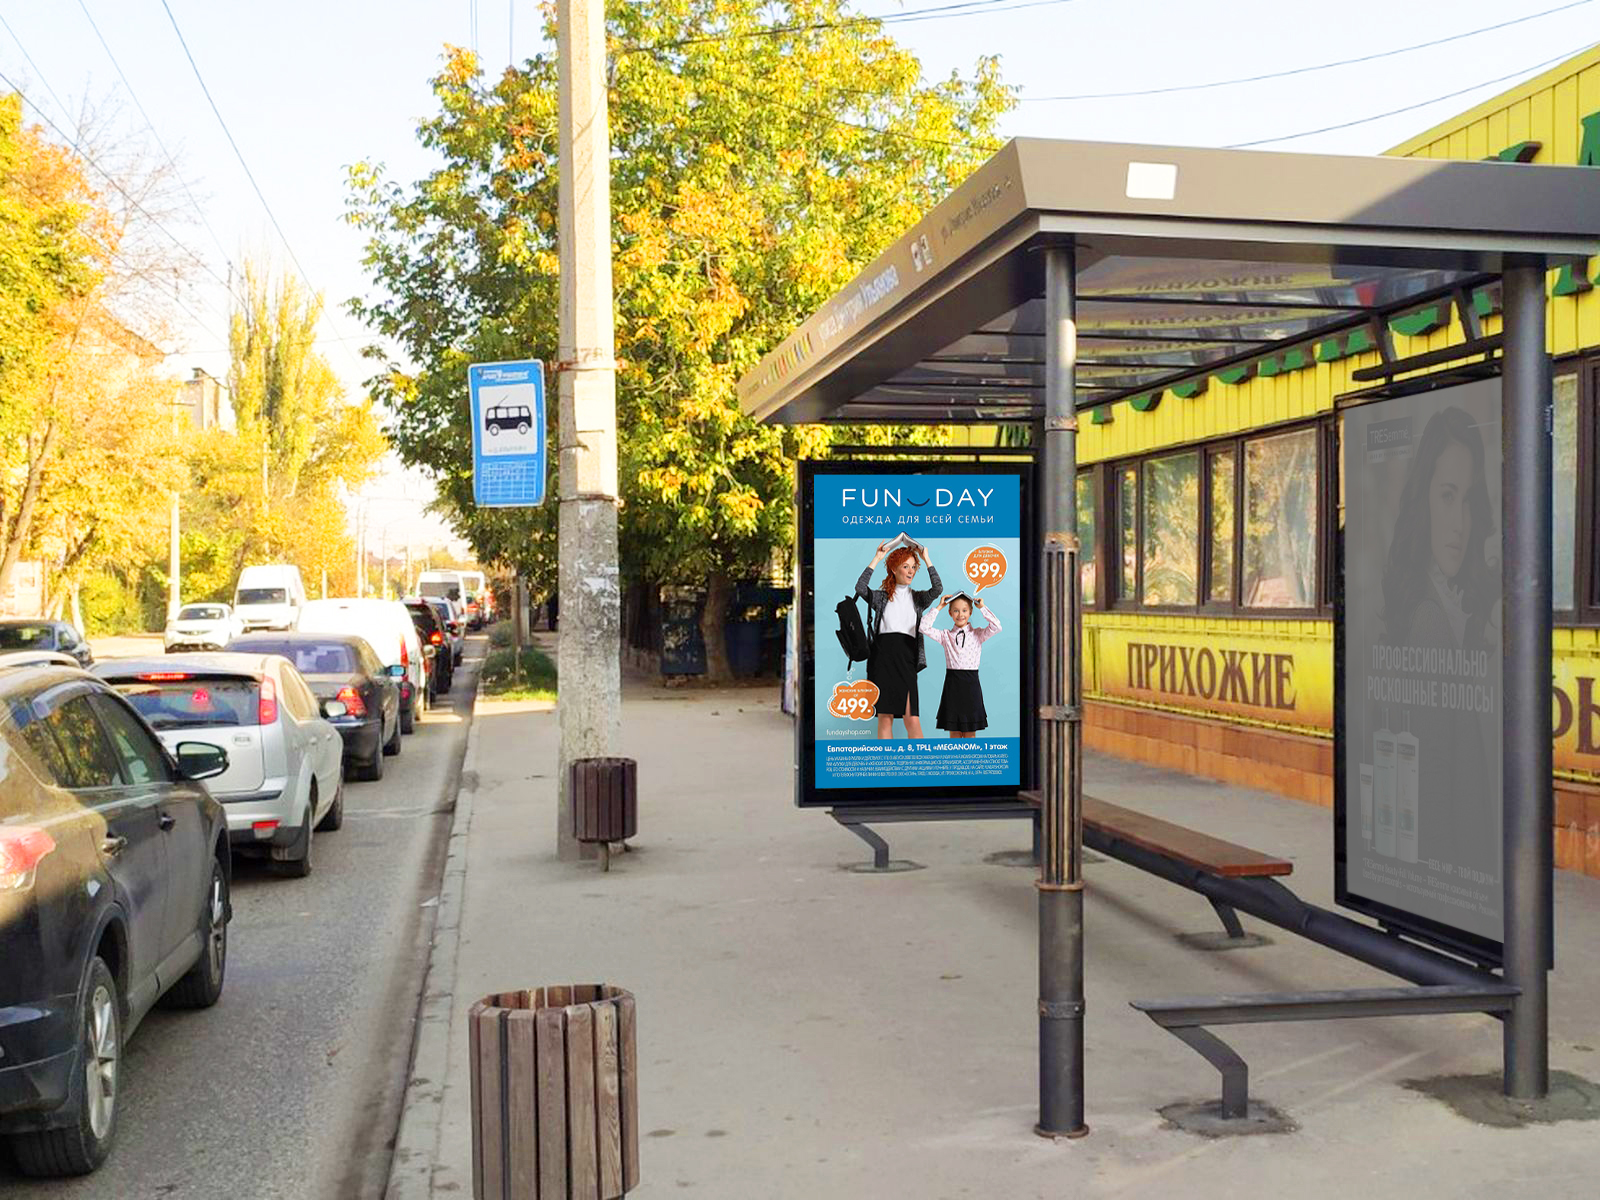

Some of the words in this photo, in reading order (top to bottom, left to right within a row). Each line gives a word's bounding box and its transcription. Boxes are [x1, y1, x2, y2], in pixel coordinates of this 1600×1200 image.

[842, 488, 901, 507] FUN
[936, 488, 994, 507] DAY
[842, 515, 892, 524] ОДЕЖДА
[897, 515, 920, 525] ДЛЯ
[925, 513, 952, 524] ВСЕЙ
[958, 515, 994, 524] СЕМЬИ
[1372, 644, 1487, 678] ПРОФЕССИОНАЛЬНО
[1127, 643, 1297, 711] ПРИХОЖИЕ
[1367, 675, 1438, 707] РОСКОШНЫЕ
[1441, 681, 1494, 714] ВОЛОСЫ
[826, 728, 871, 737] fundayshop.com
[827, 744, 883, 754] Евпаторийское
[916, 743, 931, 753] ТРЦ
[989, 743, 1008, 751] этаж
